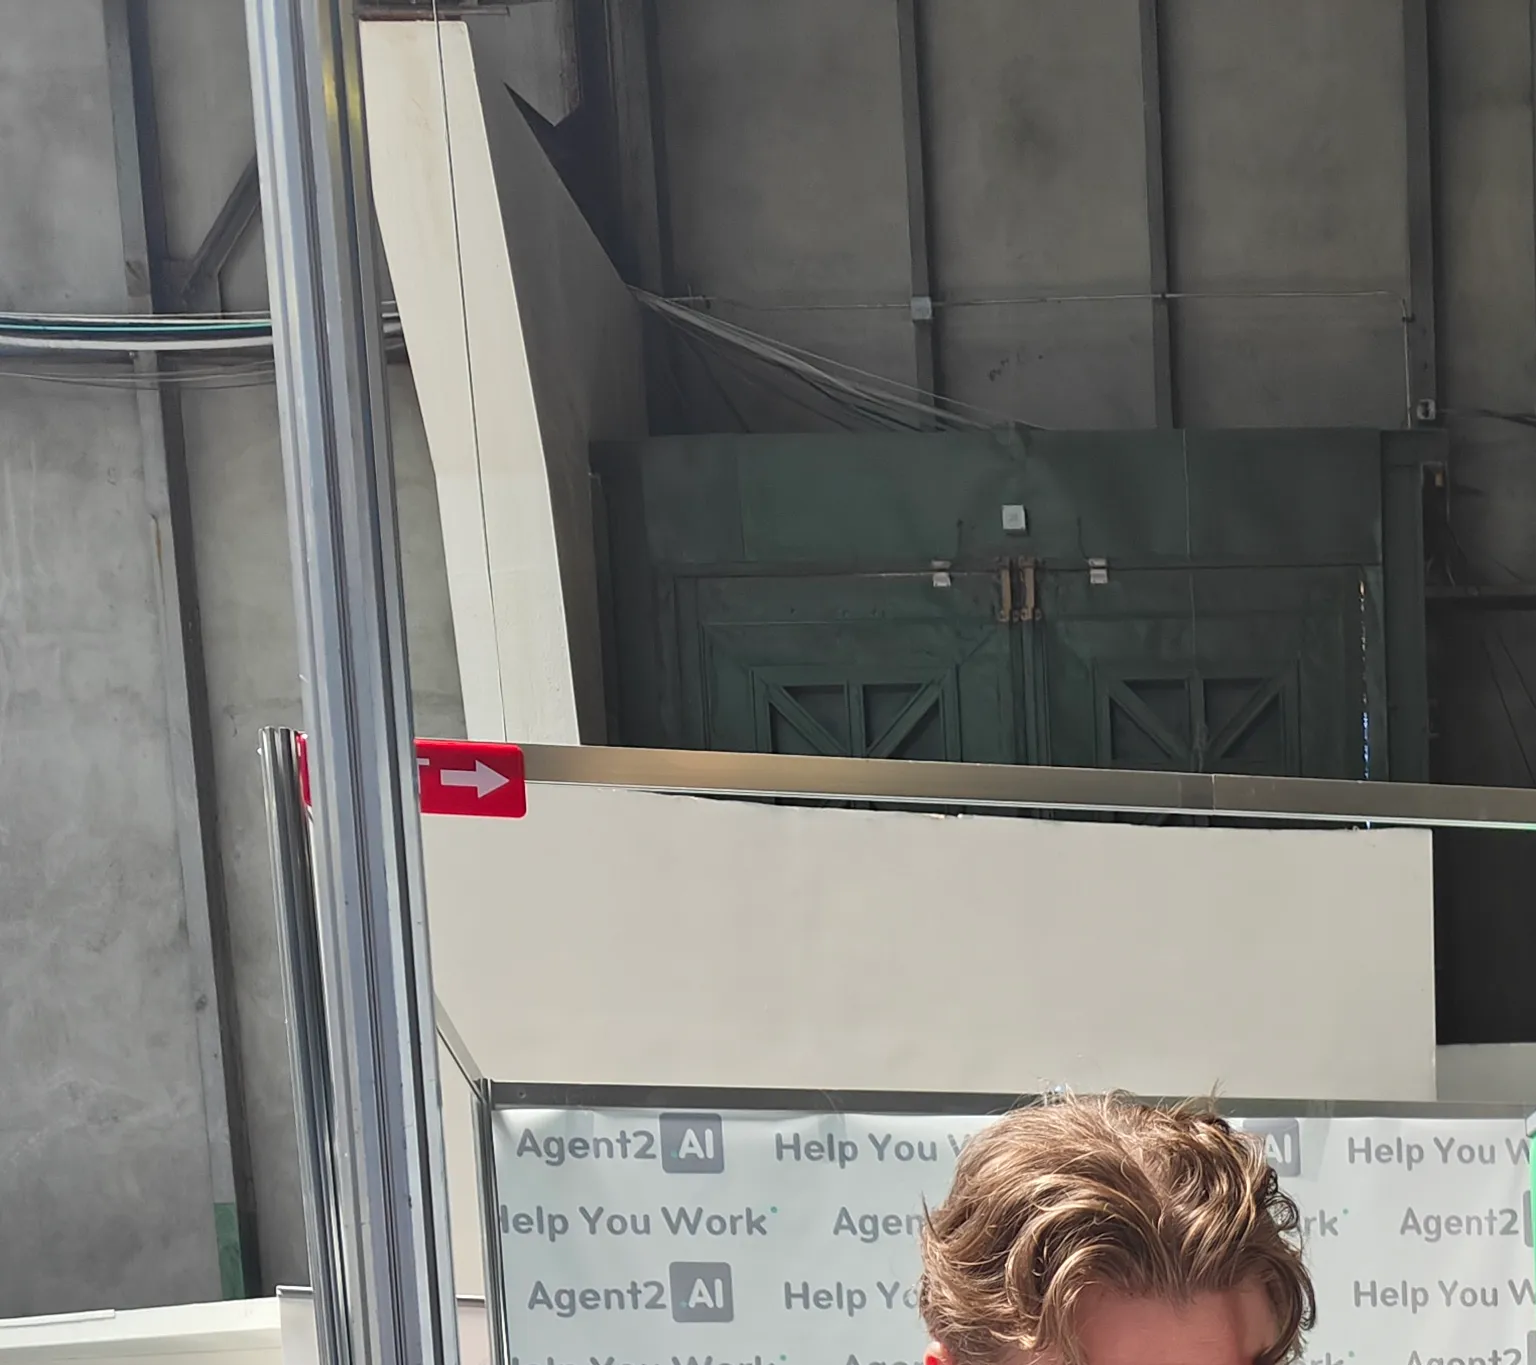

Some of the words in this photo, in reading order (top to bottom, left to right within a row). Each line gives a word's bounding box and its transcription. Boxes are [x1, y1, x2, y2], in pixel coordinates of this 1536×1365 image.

[516, 1129, 657, 1167] Agent2
[775, 1133, 858, 1168] Help
[868, 1133, 937, 1162] You
[1348, 1136, 1424, 1170] Help
[1434, 1137, 1496, 1166] You
[578, 1206, 651, 1237] You
[661, 1206, 767, 1238] Work
[1400, 1207, 1519, 1242] Agent2
[527, 1280, 667, 1318] Agent2
[784, 1281, 867, 1317] Help
[1353, 1280, 1429, 1314] Help
[1438, 1280, 1499, 1307] You
